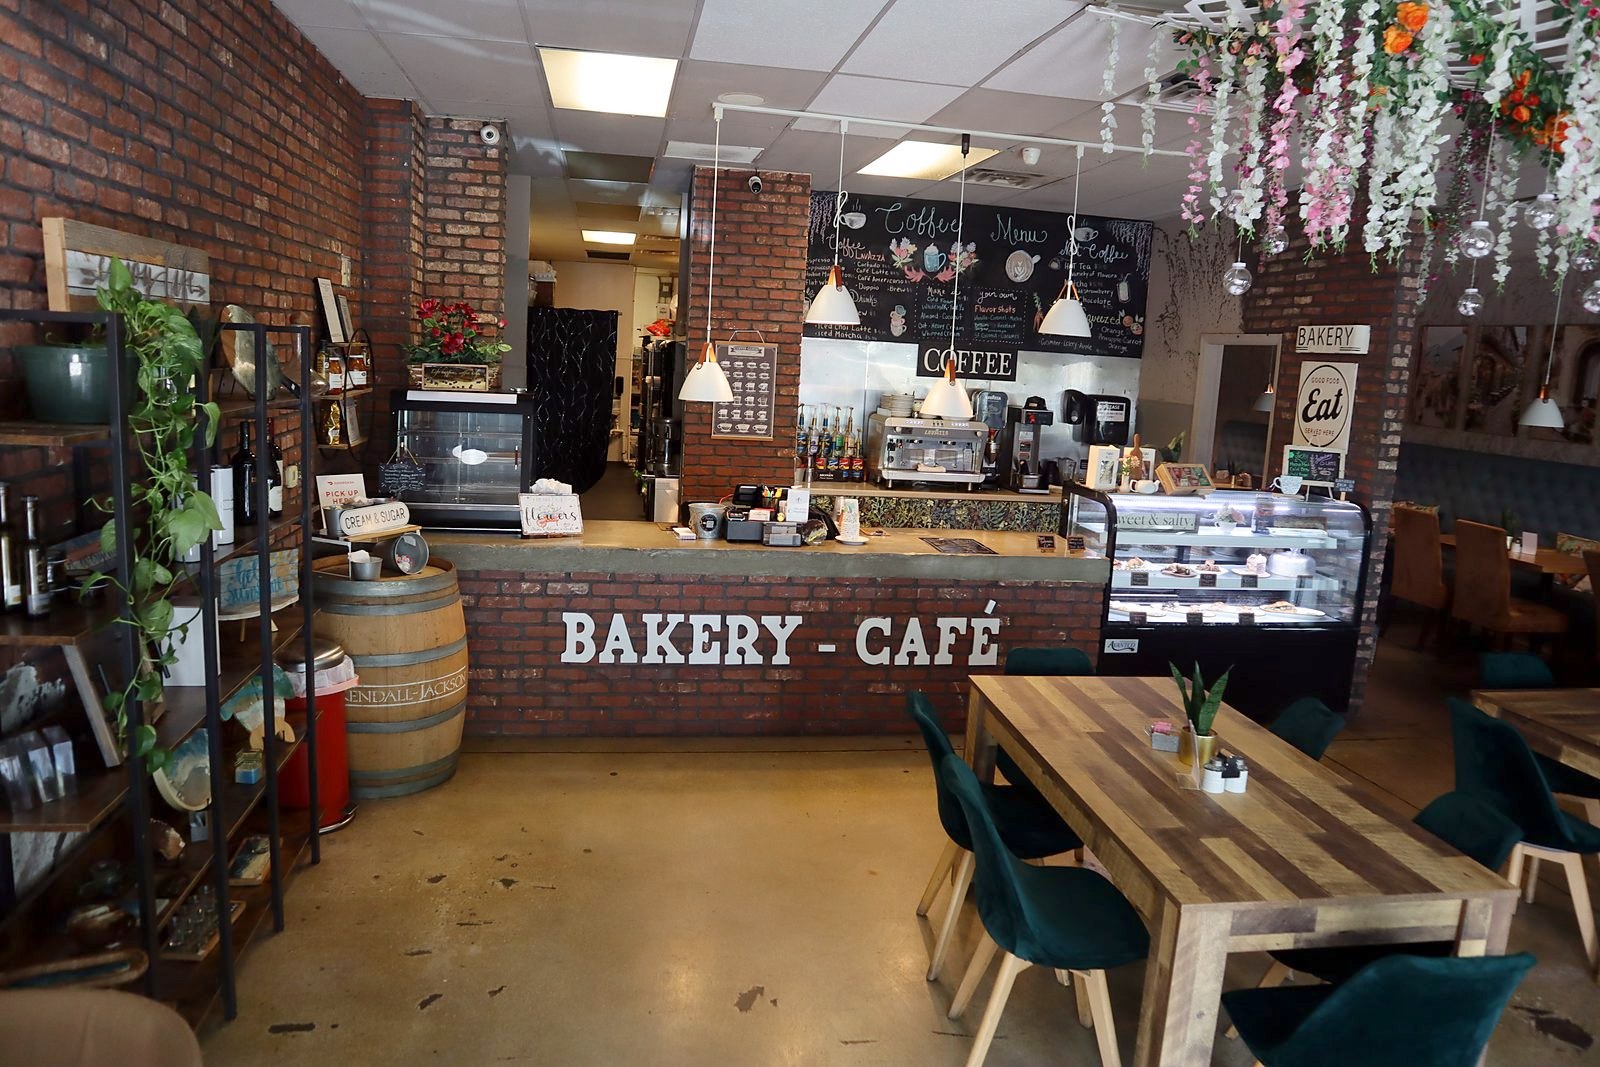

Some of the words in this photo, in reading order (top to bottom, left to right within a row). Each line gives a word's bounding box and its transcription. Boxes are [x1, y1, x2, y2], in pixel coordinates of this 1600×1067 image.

[875, 203, 962, 238] Coffee
[990, 214, 1048, 246] Menu
[826, 234, 866, 259] Coffee
[1083, 243, 1129, 263] Coffee
[1087, 314, 1121, 330] queezed
[1298, 327, 1354, 346] BAKERY
[923, 348, 1012, 376] COFFEE
[1302, 388, 1343, 423] Eat
[325, 490, 346, 498] PICK
[347, 489, 359, 497] UP
[345, 514, 371, 530] CREAM
[373, 511, 381, 524] &
[380, 507, 406, 523] SUGAR
[1117, 514, 1145, 525] weet
[1148, 513, 1159, 526] &
[1161, 513, 1194, 529] salty.
[560, 612, 803, 665] BAKERY
[856, 600, 1001, 666] CAFÉ
